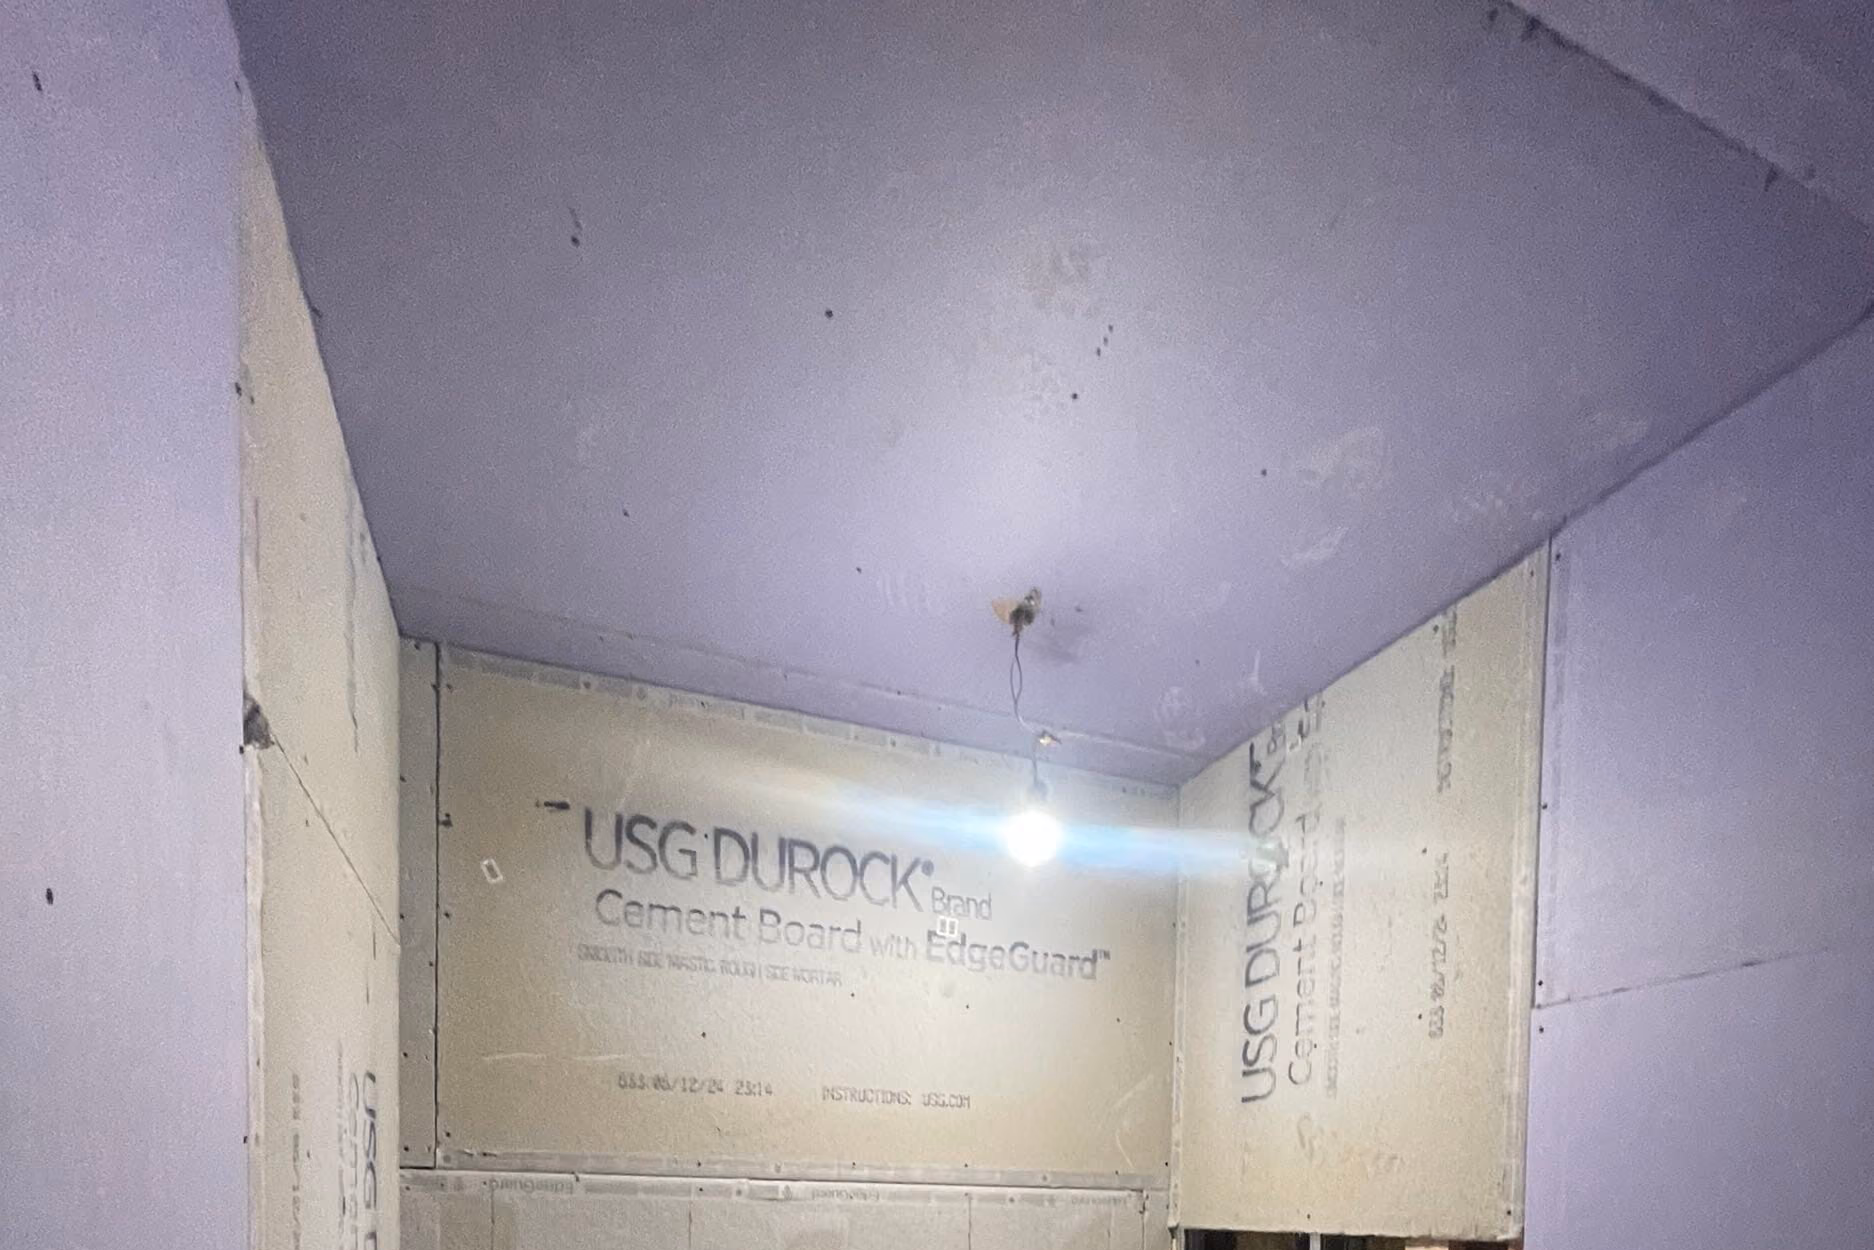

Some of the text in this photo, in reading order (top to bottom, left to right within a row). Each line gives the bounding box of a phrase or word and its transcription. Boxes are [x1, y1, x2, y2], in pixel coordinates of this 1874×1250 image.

[584, 807, 698, 881] USG
[595, 888, 748, 941] Cement
[759, 908, 862, 954] Board
[869, 933, 918, 961] with
[931, 886, 993, 921] Brand
[1241, 994, 1279, 1103] USG
[362, 1070, 378, 1209] USG
